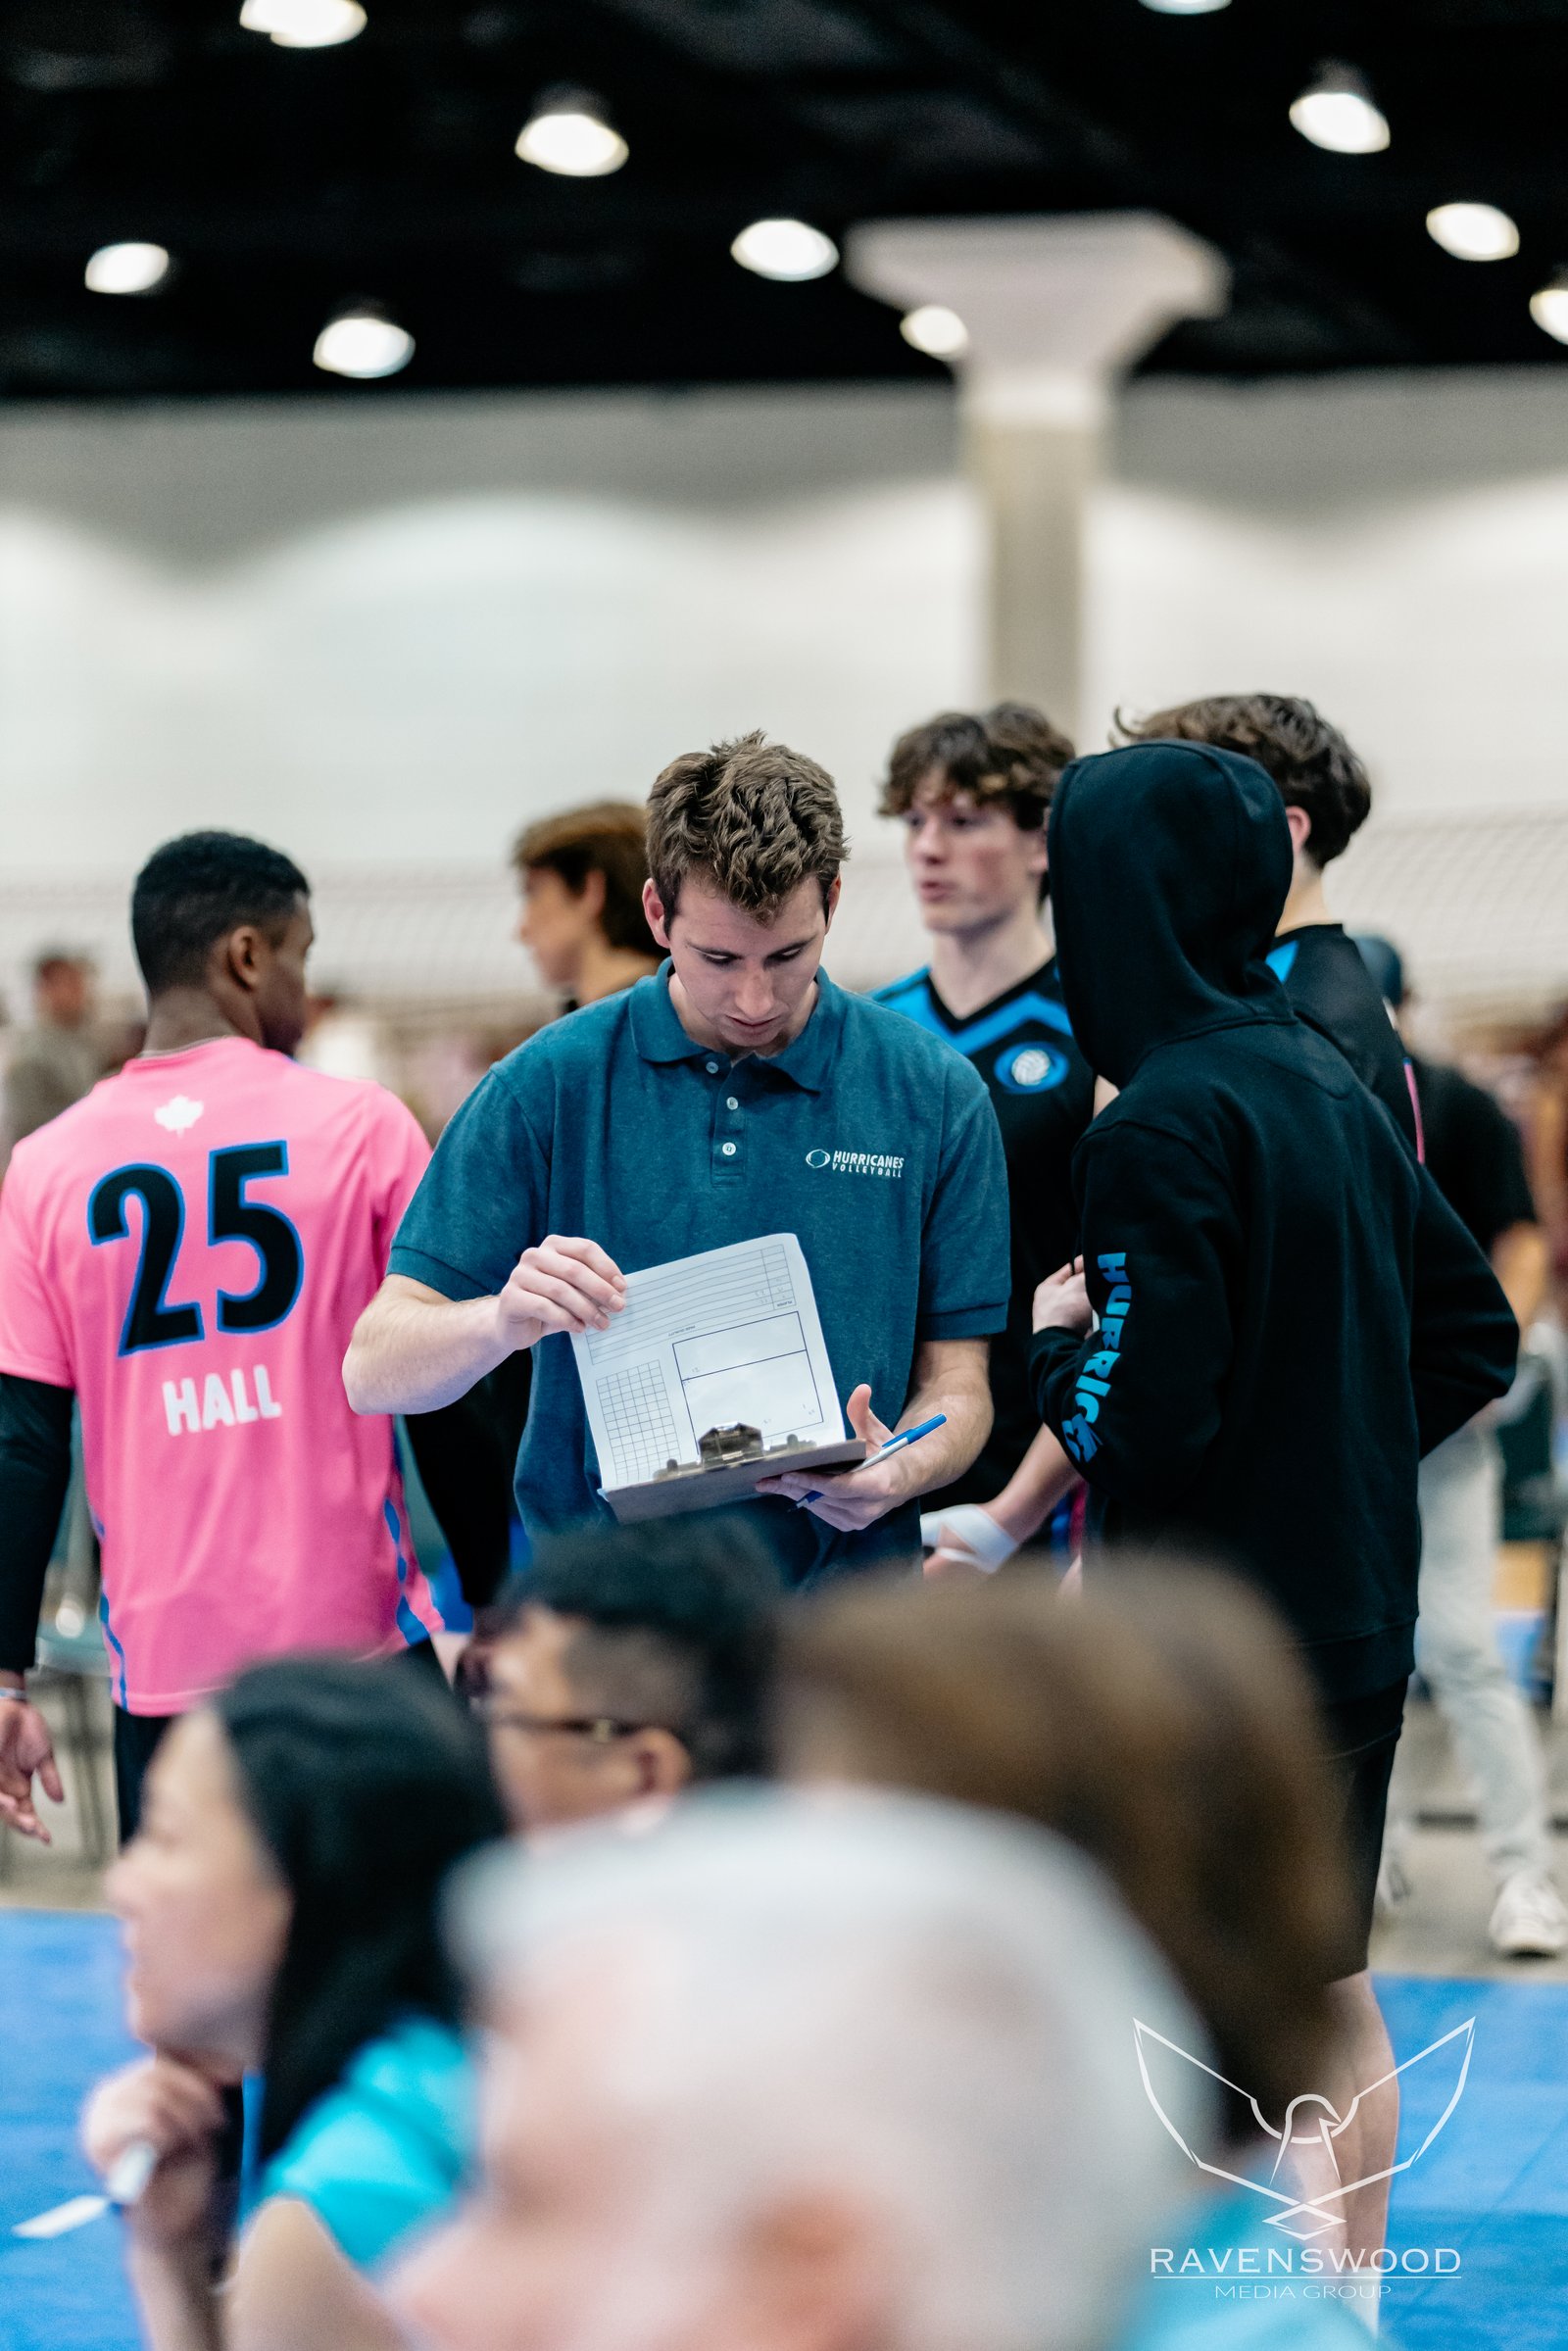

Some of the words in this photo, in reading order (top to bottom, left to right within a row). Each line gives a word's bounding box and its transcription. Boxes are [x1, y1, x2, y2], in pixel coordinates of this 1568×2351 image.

[832, 1163, 902, 1177] VOLLEYBALL
[833, 1151, 904, 1168] HURRICANES
[86, 1140, 305, 1358] 25
[1062, 1251, 1132, 1462] HURRIC
[162, 1364, 282, 1437] HALL
